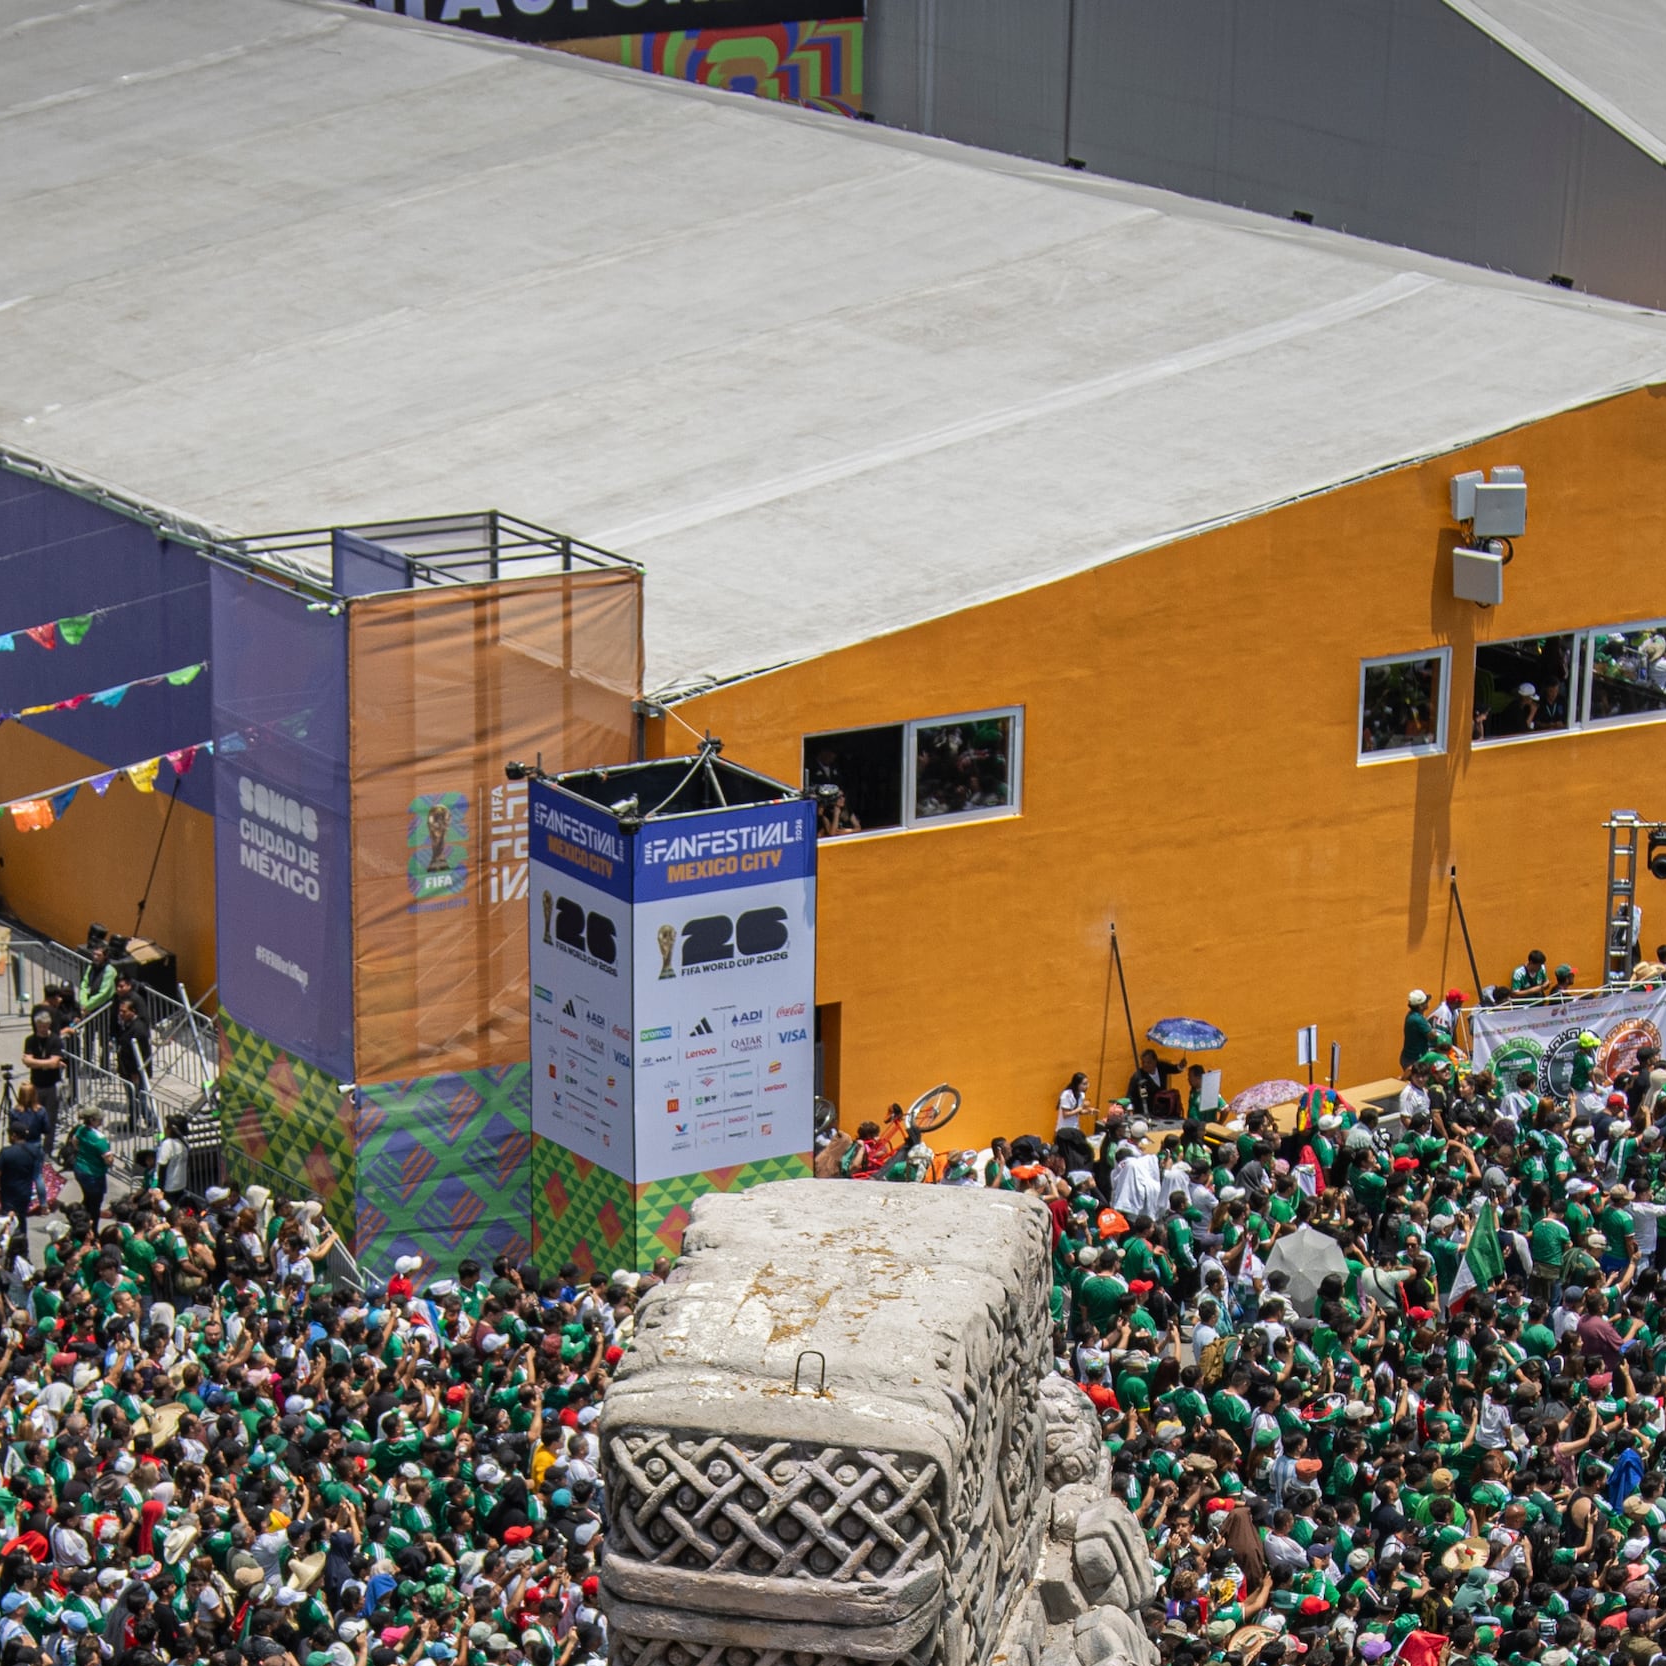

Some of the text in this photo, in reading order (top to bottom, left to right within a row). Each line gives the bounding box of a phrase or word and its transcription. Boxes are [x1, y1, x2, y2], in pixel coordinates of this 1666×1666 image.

[239, 775, 319, 843] SOMOS
[491, 785, 503, 822] FIFA
[240, 817, 320, 875] CIUDAD DE
[644, 842, 652, 865] FIFA
[425, 875, 452, 889] FIFA
[667, 849, 783, 883] MEXICO CITY
[556, 897, 616, 964] 26
[681, 906, 788, 966] 26
[681, 951, 788, 977] FIFA WORLD CUP 2026
[740, 1009, 763, 1022] ADI
[641, 1028, 671, 1040] aramco
[685, 1027, 808, 1060] Lenovo QATAR VISA
